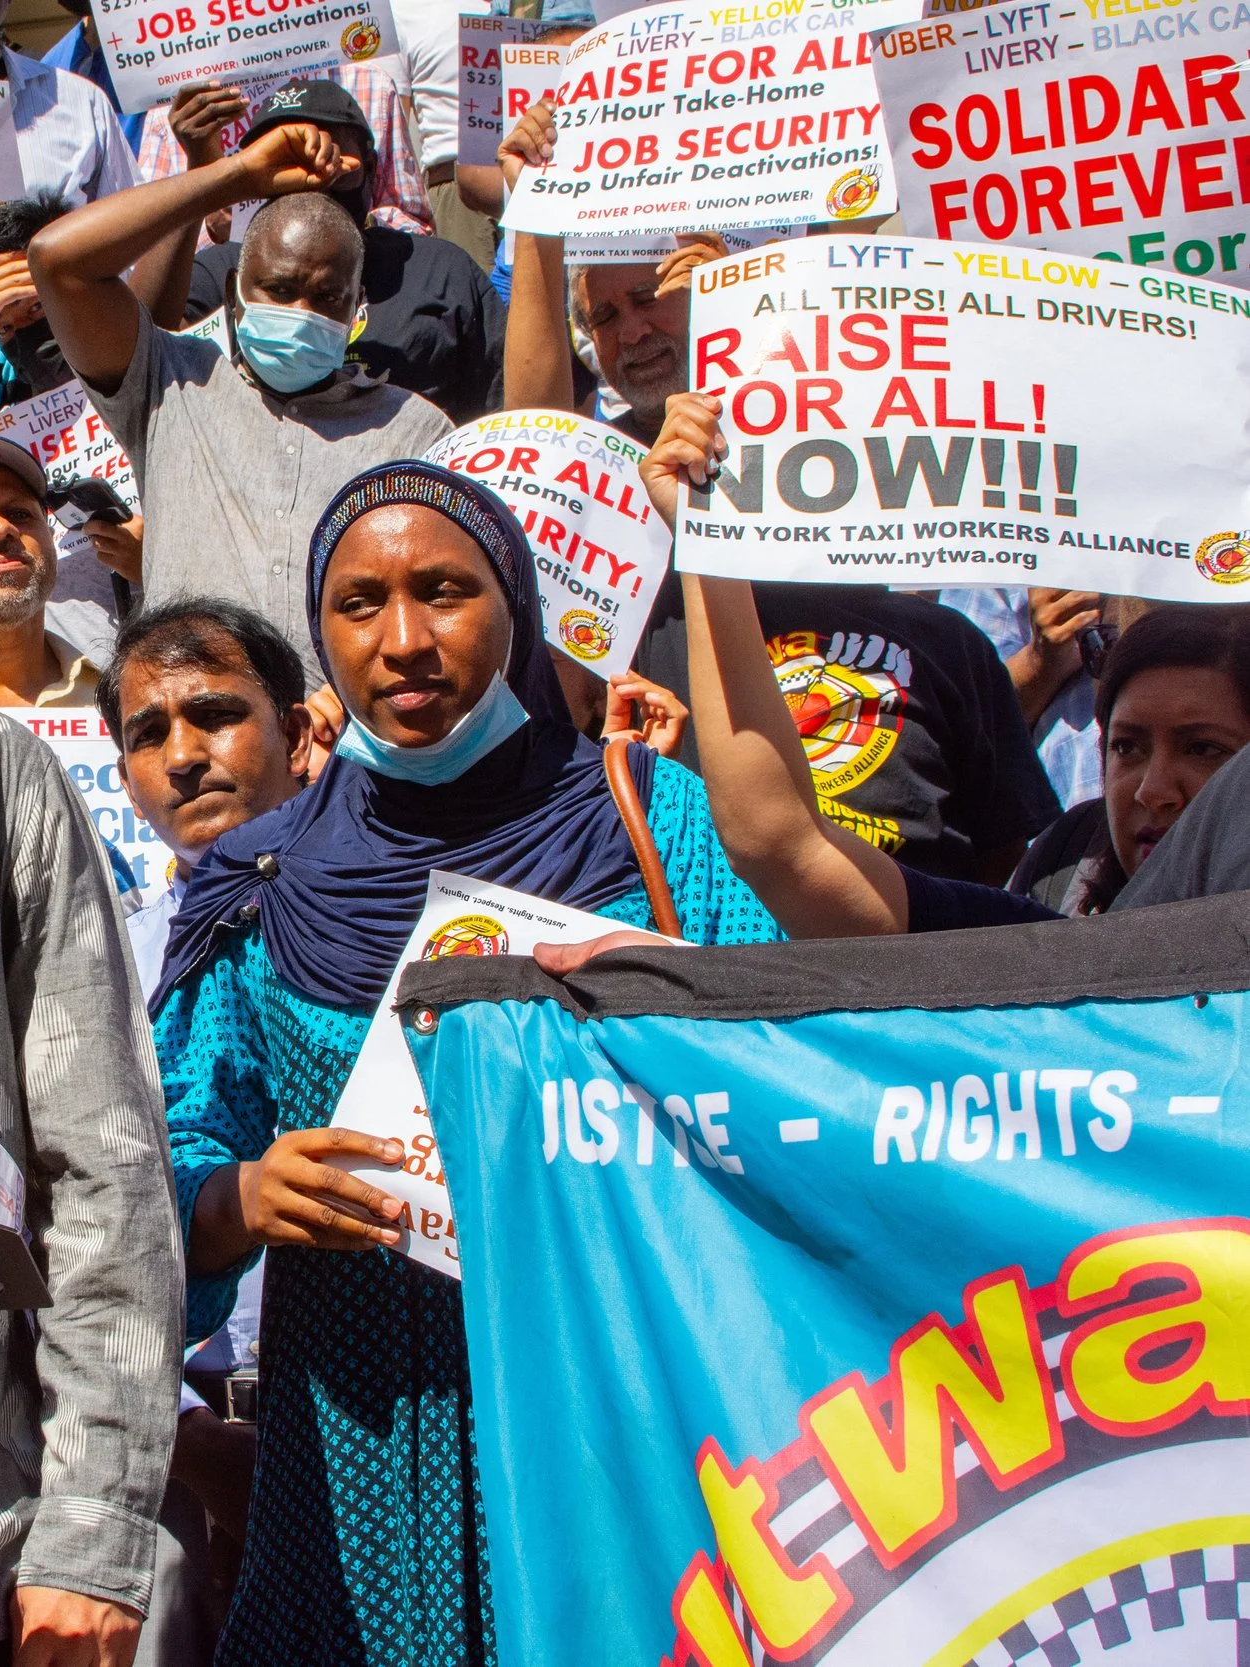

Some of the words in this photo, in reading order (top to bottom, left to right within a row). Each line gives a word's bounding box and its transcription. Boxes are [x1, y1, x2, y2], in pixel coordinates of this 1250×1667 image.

[116, 48, 156, 70] Stop
[160, 31, 221, 58] Unfair
[227, 1, 371, 43] Deactivations!
[135, 7, 197, 45] JOB
[460, 18, 503, 32] UBER
[566, 32, 609, 66] UBER
[630, 14, 685, 38] LYFT
[710, 0, 805, 27] YELLOW
[617, 30, 696, 58] LIVERY
[720, 16, 799, 43] BLACK
[806, 9, 855, 32] CAR
[879, 23, 957, 60] UBER
[986, 4, 1051, 39] LYFT
[965, 35, 1059, 75] LIVERY
[1092, 11, 1202, 53] BLACK
[1208, 3, 1250, 33] CA
[158, 70, 194, 87] DRIVER
[196, 61, 239, 78] POWER!
[242, 51, 283, 67] UNION
[285, 41, 330, 58] POWER!
[252, 69, 290, 85] ALLIANCE
[292, 58, 339, 75] NYTWA.ORG
[505, 50, 560, 65] UBER
[553, 57, 667, 108] RAISE
[684, 44, 777, 89] FOR
[673, 80, 825, 115] Take-Home
[908, 54, 1250, 170] SOLIDAR
[530, 176, 591, 199] Stop
[600, 168, 683, 194] Unfair
[691, 145, 879, 183] Deactivations!
[573, 133, 660, 174] JOB
[577, 206, 631, 220] DRIVER
[633, 202, 691, 216] POWER!
[696, 196, 750, 211] UNION
[755, 190, 813, 206] POWER!
[617, 227, 641, 237] TAXI
[643, 224, 697, 236] WORKERS
[699, 220, 751, 232] ALLIANCE
[753, 214, 817, 228] NYTWA.ORG
[580, 249, 606, 257] YORK
[608, 249, 629, 257] TAXI
[699, 253, 786, 294] UBER
[827, 246, 914, 270] LYFT
[954, 252, 1100, 290] YELLOW
[1139, 276, 1250, 319] GREEN
[753, 288, 821, 317] ALL
[831, 286, 946, 312] TRIPS!
[958, 292, 1026, 319] ALL
[1037, 299, 1198, 340] DRIVERS!
[696, 313, 950, 391] RAISE
[29, 399, 84, 435] LIVERY
[31, 388, 70, 417] LYFT
[871, 377, 1047, 434] ALL!
[477, 415, 579, 435] YELLOW
[483, 428, 567, 449] BLACK
[575, 439, 626, 474] CAR
[554, 460, 651, 526] ALL!
[686, 434, 1079, 518] NOW!!!
[684, 520, 745, 541] NEW
[754, 525, 831, 543] YORK
[840, 523, 904, 542] TAXI
[912, 521, 1050, 545] WORKERS
[1058, 530, 1191, 560] ALLIANCE
[827, 547, 1038, 570] www.nytwa.org
[27, 719, 87, 737] THE
[854, 730, 892, 775] ALLIANCE
[437, 885, 470, 902] Dignity.
[472, 896, 505, 912] Respect.
[507, 906, 534, 921] Rights.
[536, 915, 567, 930] Justice.
[873, 1069, 1139, 1166] RIGHTS
